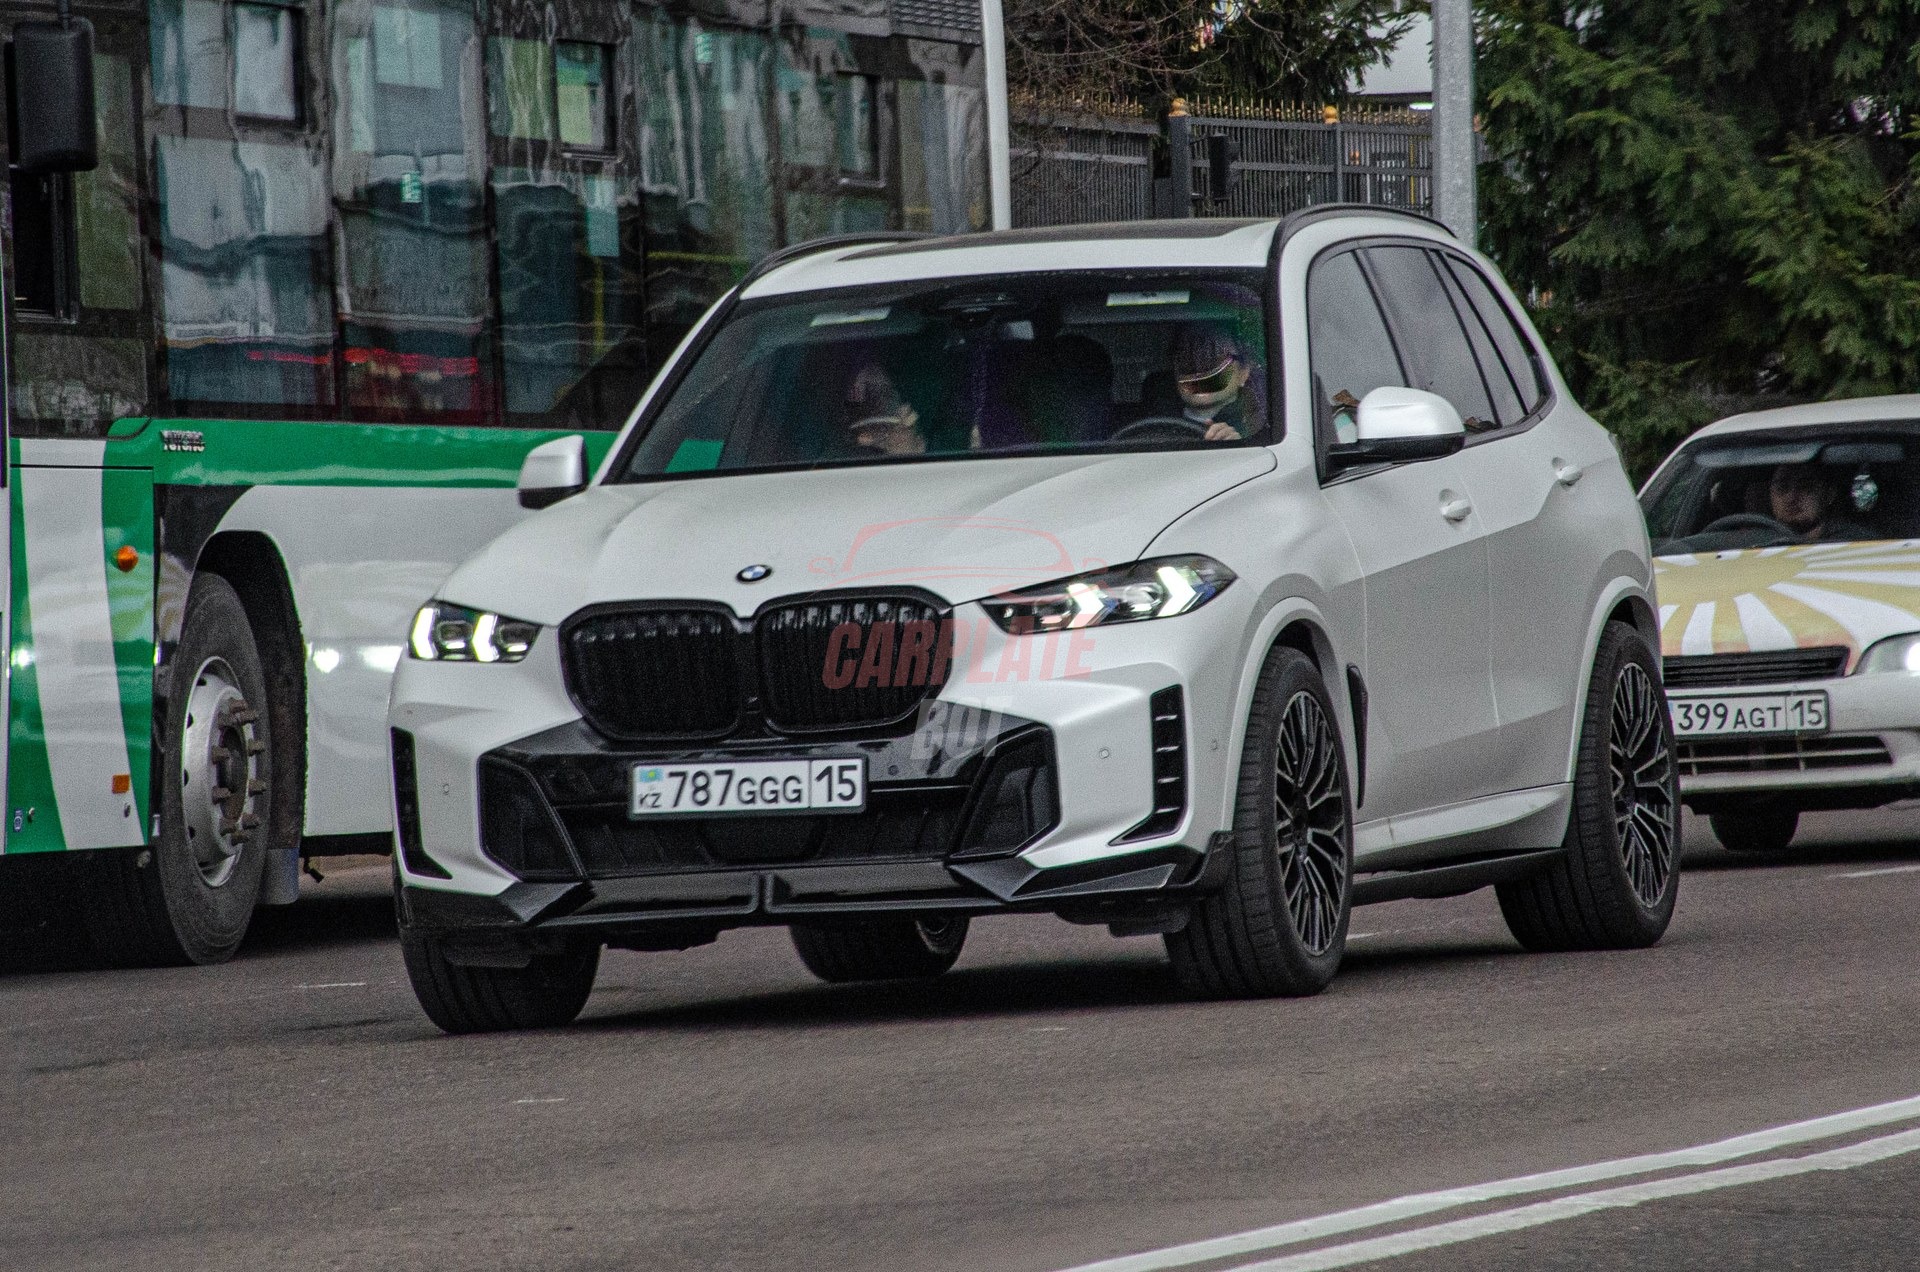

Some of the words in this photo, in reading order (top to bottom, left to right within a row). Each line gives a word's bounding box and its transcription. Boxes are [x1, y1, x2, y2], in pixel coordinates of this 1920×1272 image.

[1790, 699, 1823, 727] 15
[639, 793, 662, 809] KZ
[815, 764, 858, 803] 15
